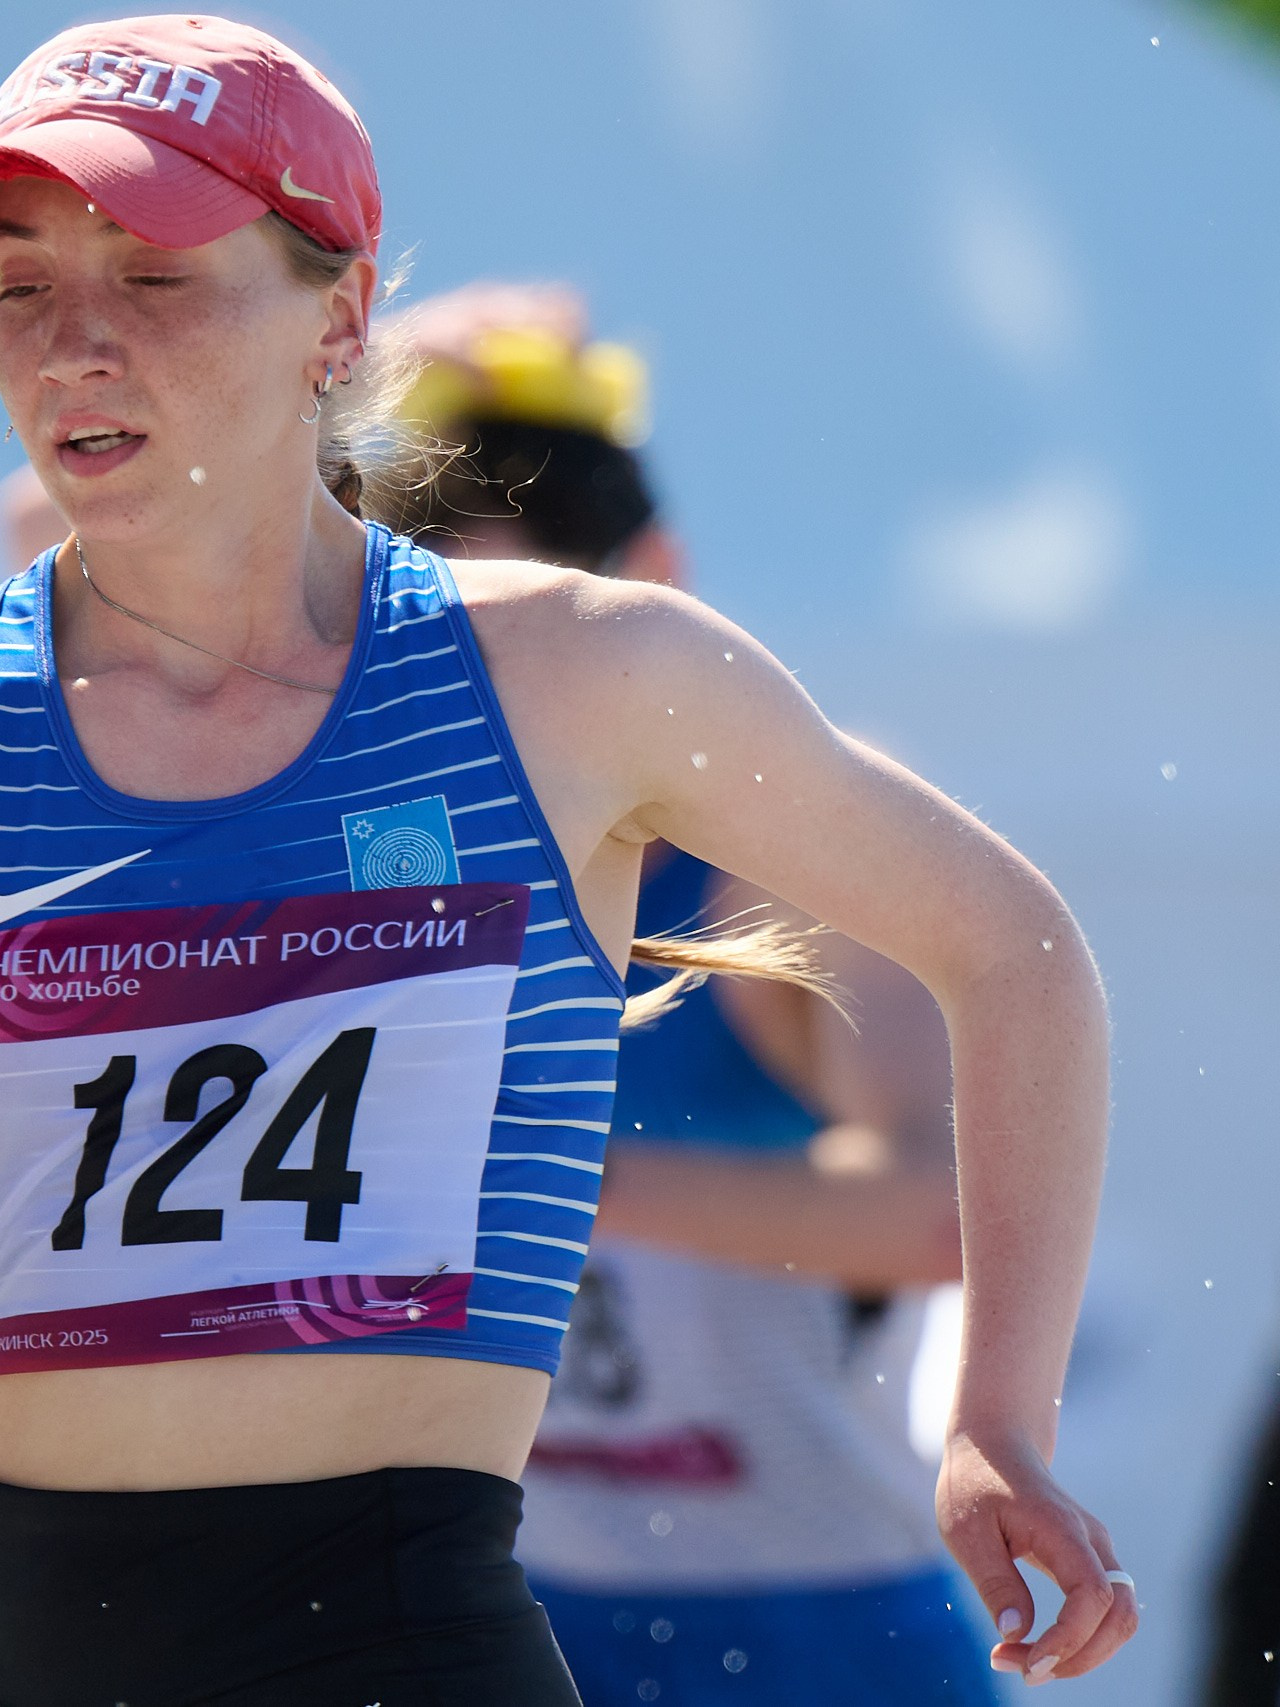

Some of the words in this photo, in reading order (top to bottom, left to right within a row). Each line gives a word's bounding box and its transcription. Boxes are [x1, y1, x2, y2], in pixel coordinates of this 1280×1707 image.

[280, 918, 467, 962] РОССИИ
[28, 974, 141, 1002] ходьбе
[51, 1027, 377, 1251] 124
[238, 1306, 300, 1323] АТЛЕТИКИ
[57, 1328, 109, 1348] 2025
